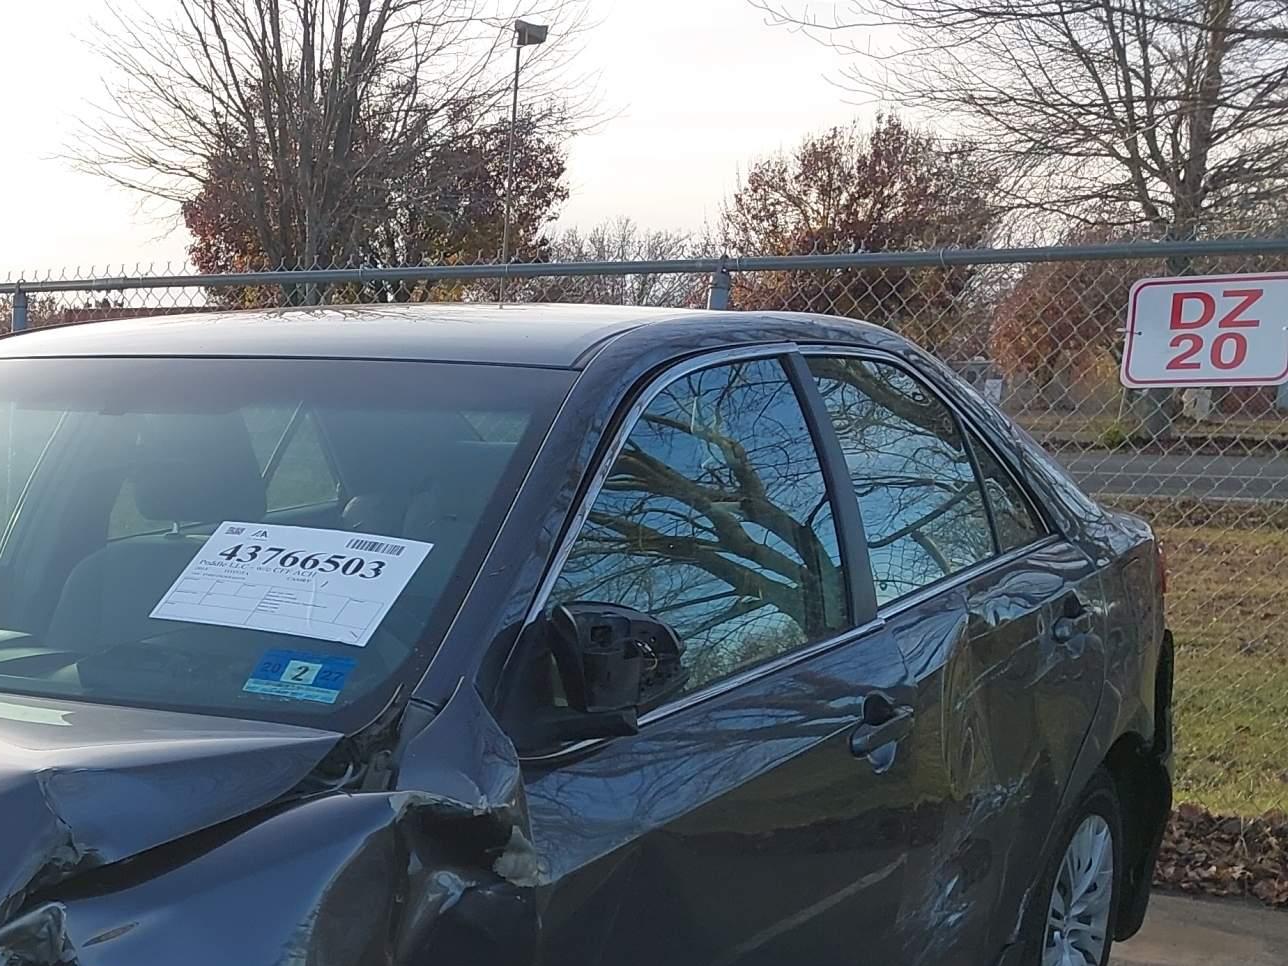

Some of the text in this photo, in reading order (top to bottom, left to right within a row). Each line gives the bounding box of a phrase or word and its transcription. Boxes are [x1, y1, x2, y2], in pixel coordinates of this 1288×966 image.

[1169, 288, 1264, 330] DZ
[1165, 331, 1248, 370] 20
[219, 542, 387, 580] 43766503
[291, 665, 310, 681] 2
